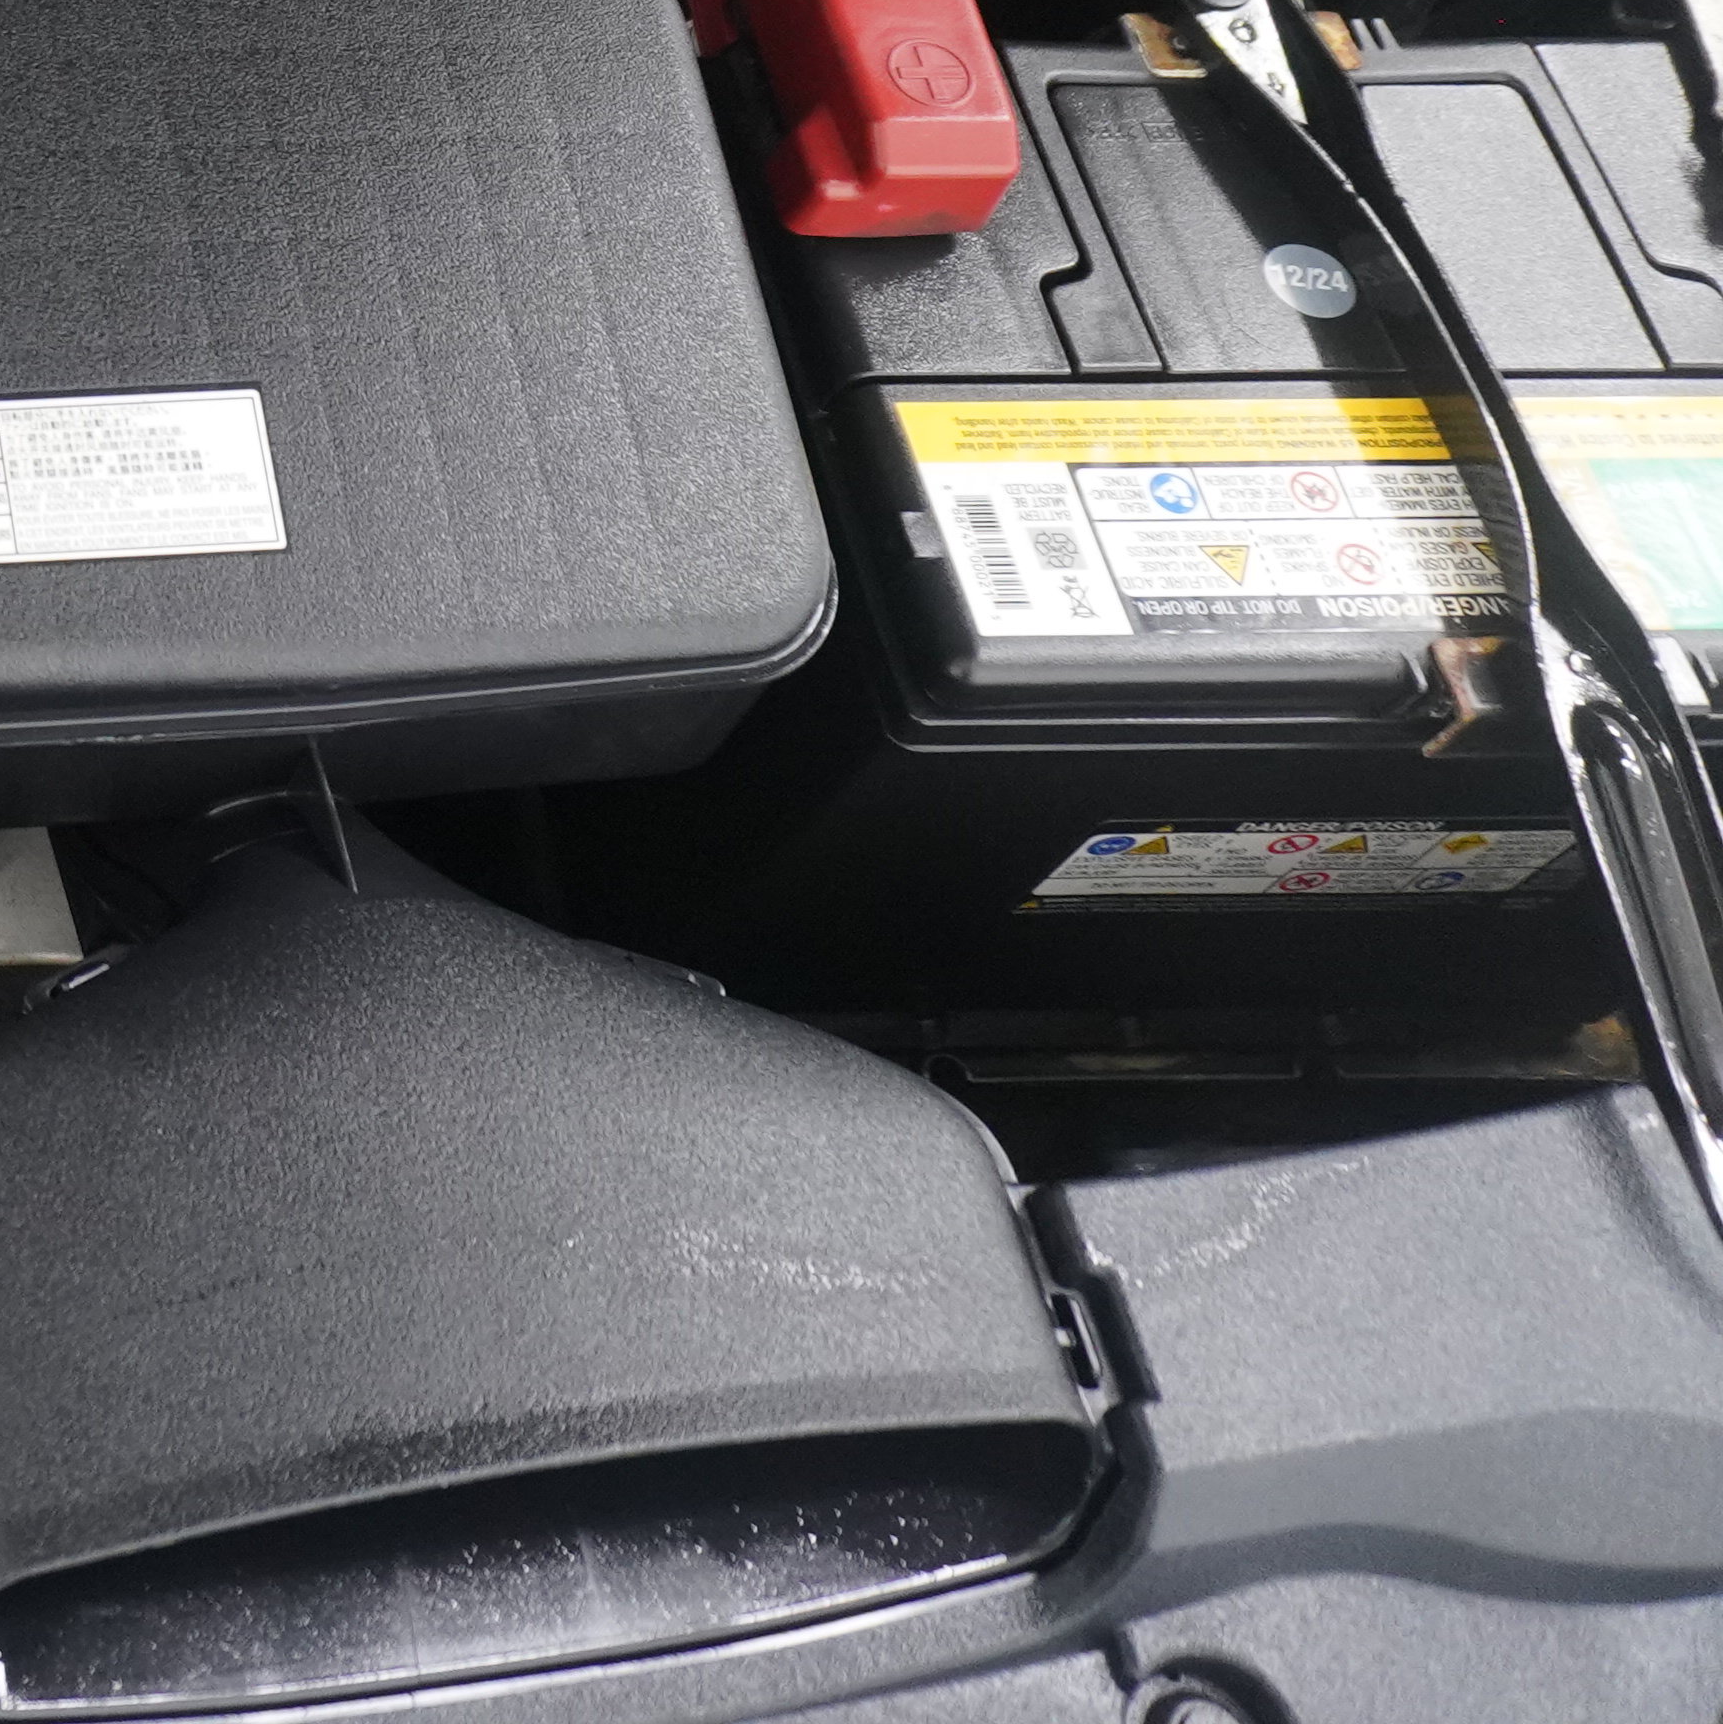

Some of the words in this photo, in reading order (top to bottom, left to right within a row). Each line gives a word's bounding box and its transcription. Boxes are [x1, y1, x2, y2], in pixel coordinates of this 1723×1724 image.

[1269, 263, 1349, 293] 12/24
[1357, 438, 1444, 449] PROPOSITION
[1269, 474, 1285, 486] OF
[1400, 473, 1431, 485] HELP
[1220, 487, 1263, 499] REACH
[1268, 487, 1289, 499] THE
[1424, 485, 1456, 497] WITH
[1011, 496, 1027, 509] BE
[1031, 496, 1066, 509] MUST
[1118, 502, 1151, 514] READ
[1218, 501, 1231, 513] OF
[1237, 501, 1261, 513] OUT
[1265, 501, 1297, 513] KEEP
[1427, 499, 1459, 511] EYES
[1017, 509, 1072, 522] BATTERY
[1181, 530, 1226, 542] SEVERE
[1230, 530, 1248, 542] OR
[1433, 526, 1450, 538] OR
[1258, 533, 1317, 545] SMOKING
[1126, 545, 1196, 557] BLINDNESS
[1273, 547, 1323, 559] FLAMES
[1418, 543, 1469, 555] GASES
[1139, 560, 1179, 572] CAUSE
[1181, 560, 1210, 572] CAN
[1404, 557, 1485, 571] EXPLOSIVE
[1117, 575, 1153, 589] ACID
[1158, 575, 1230, 589] SULFURIC
[1185, 598, 1209, 617] OR
[1212, 598, 1237, 617] TIP
[1243, 598, 1273, 617] NOT
[1277, 598, 1302, 617] DO
[1315, 596, 1512, 618] ANGER/POISON
